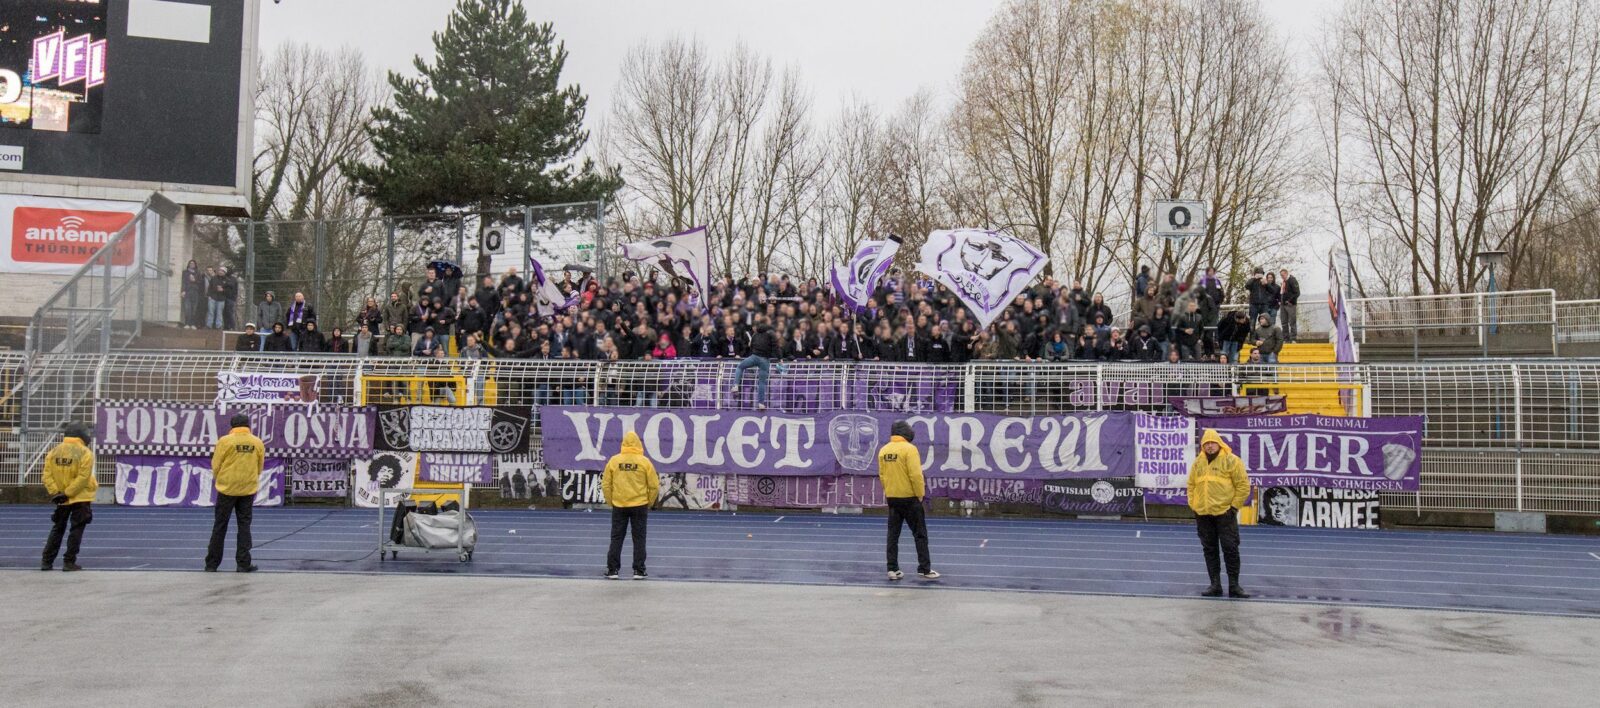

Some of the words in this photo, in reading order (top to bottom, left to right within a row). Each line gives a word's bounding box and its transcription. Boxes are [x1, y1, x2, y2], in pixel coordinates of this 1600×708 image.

[25, 243, 122, 256] THÜRING
[410, 405, 493, 431] SEZIONE
[1136, 414, 1190, 430] ULTRAS
[1247, 417, 1282, 428] EIMER
[1290, 416, 1307, 426] IST
[1316, 417, 1369, 430] KEINMAL
[104, 407, 218, 446] FORZA
[284, 411, 370, 450] OSNA
[410, 428, 491, 452] CAPANNA
[562, 410, 815, 470] VIOLET
[908, 415, 1108, 474] CREW
[1137, 432, 1189, 446] PASSION
[1141, 447, 1185, 461] BEFORE
[1217, 432, 1374, 477] IMER
[429, 465, 483, 482] RHEINE
[1137, 461, 1188, 475] FASHION
[115, 460, 284, 506] HÜTE
[293, 480, 346, 491] TRIER
[1277, 477, 1319, 487] SAUFEN
[1332, 478, 1404, 491] SCHMEISSEN
[1115, 488, 1144, 497] GUYS
[1300, 500, 1380, 530] ARMEE
